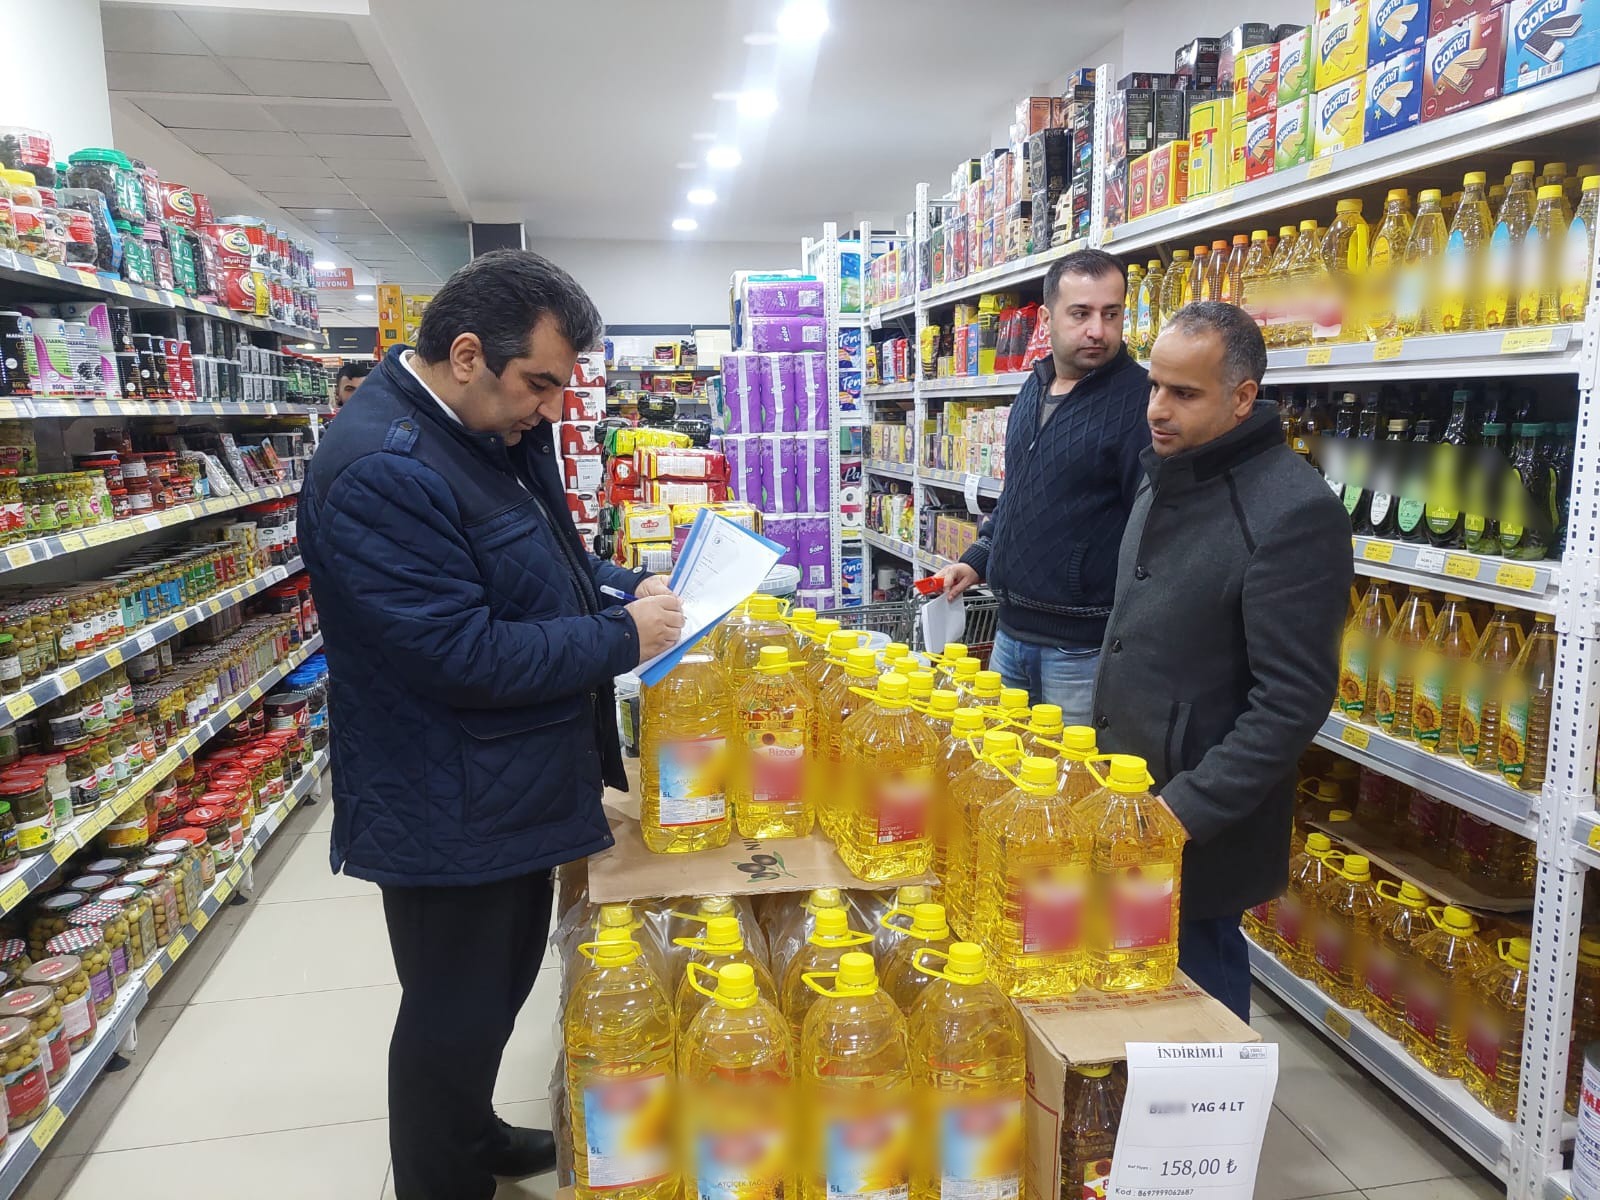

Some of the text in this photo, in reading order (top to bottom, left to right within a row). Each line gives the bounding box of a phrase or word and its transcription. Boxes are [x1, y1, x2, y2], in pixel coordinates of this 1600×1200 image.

[768, 748, 796, 757] Bizce
[1157, 1045, 1223, 1059] İNDİRİMLİ
[1191, 1102, 1215, 1113] YAG
[1219, 1102, 1226, 1111] 4
[1230, 1101, 1244, 1111] LT
[1160, 1158, 1238, 1178] 158,00 ₺
